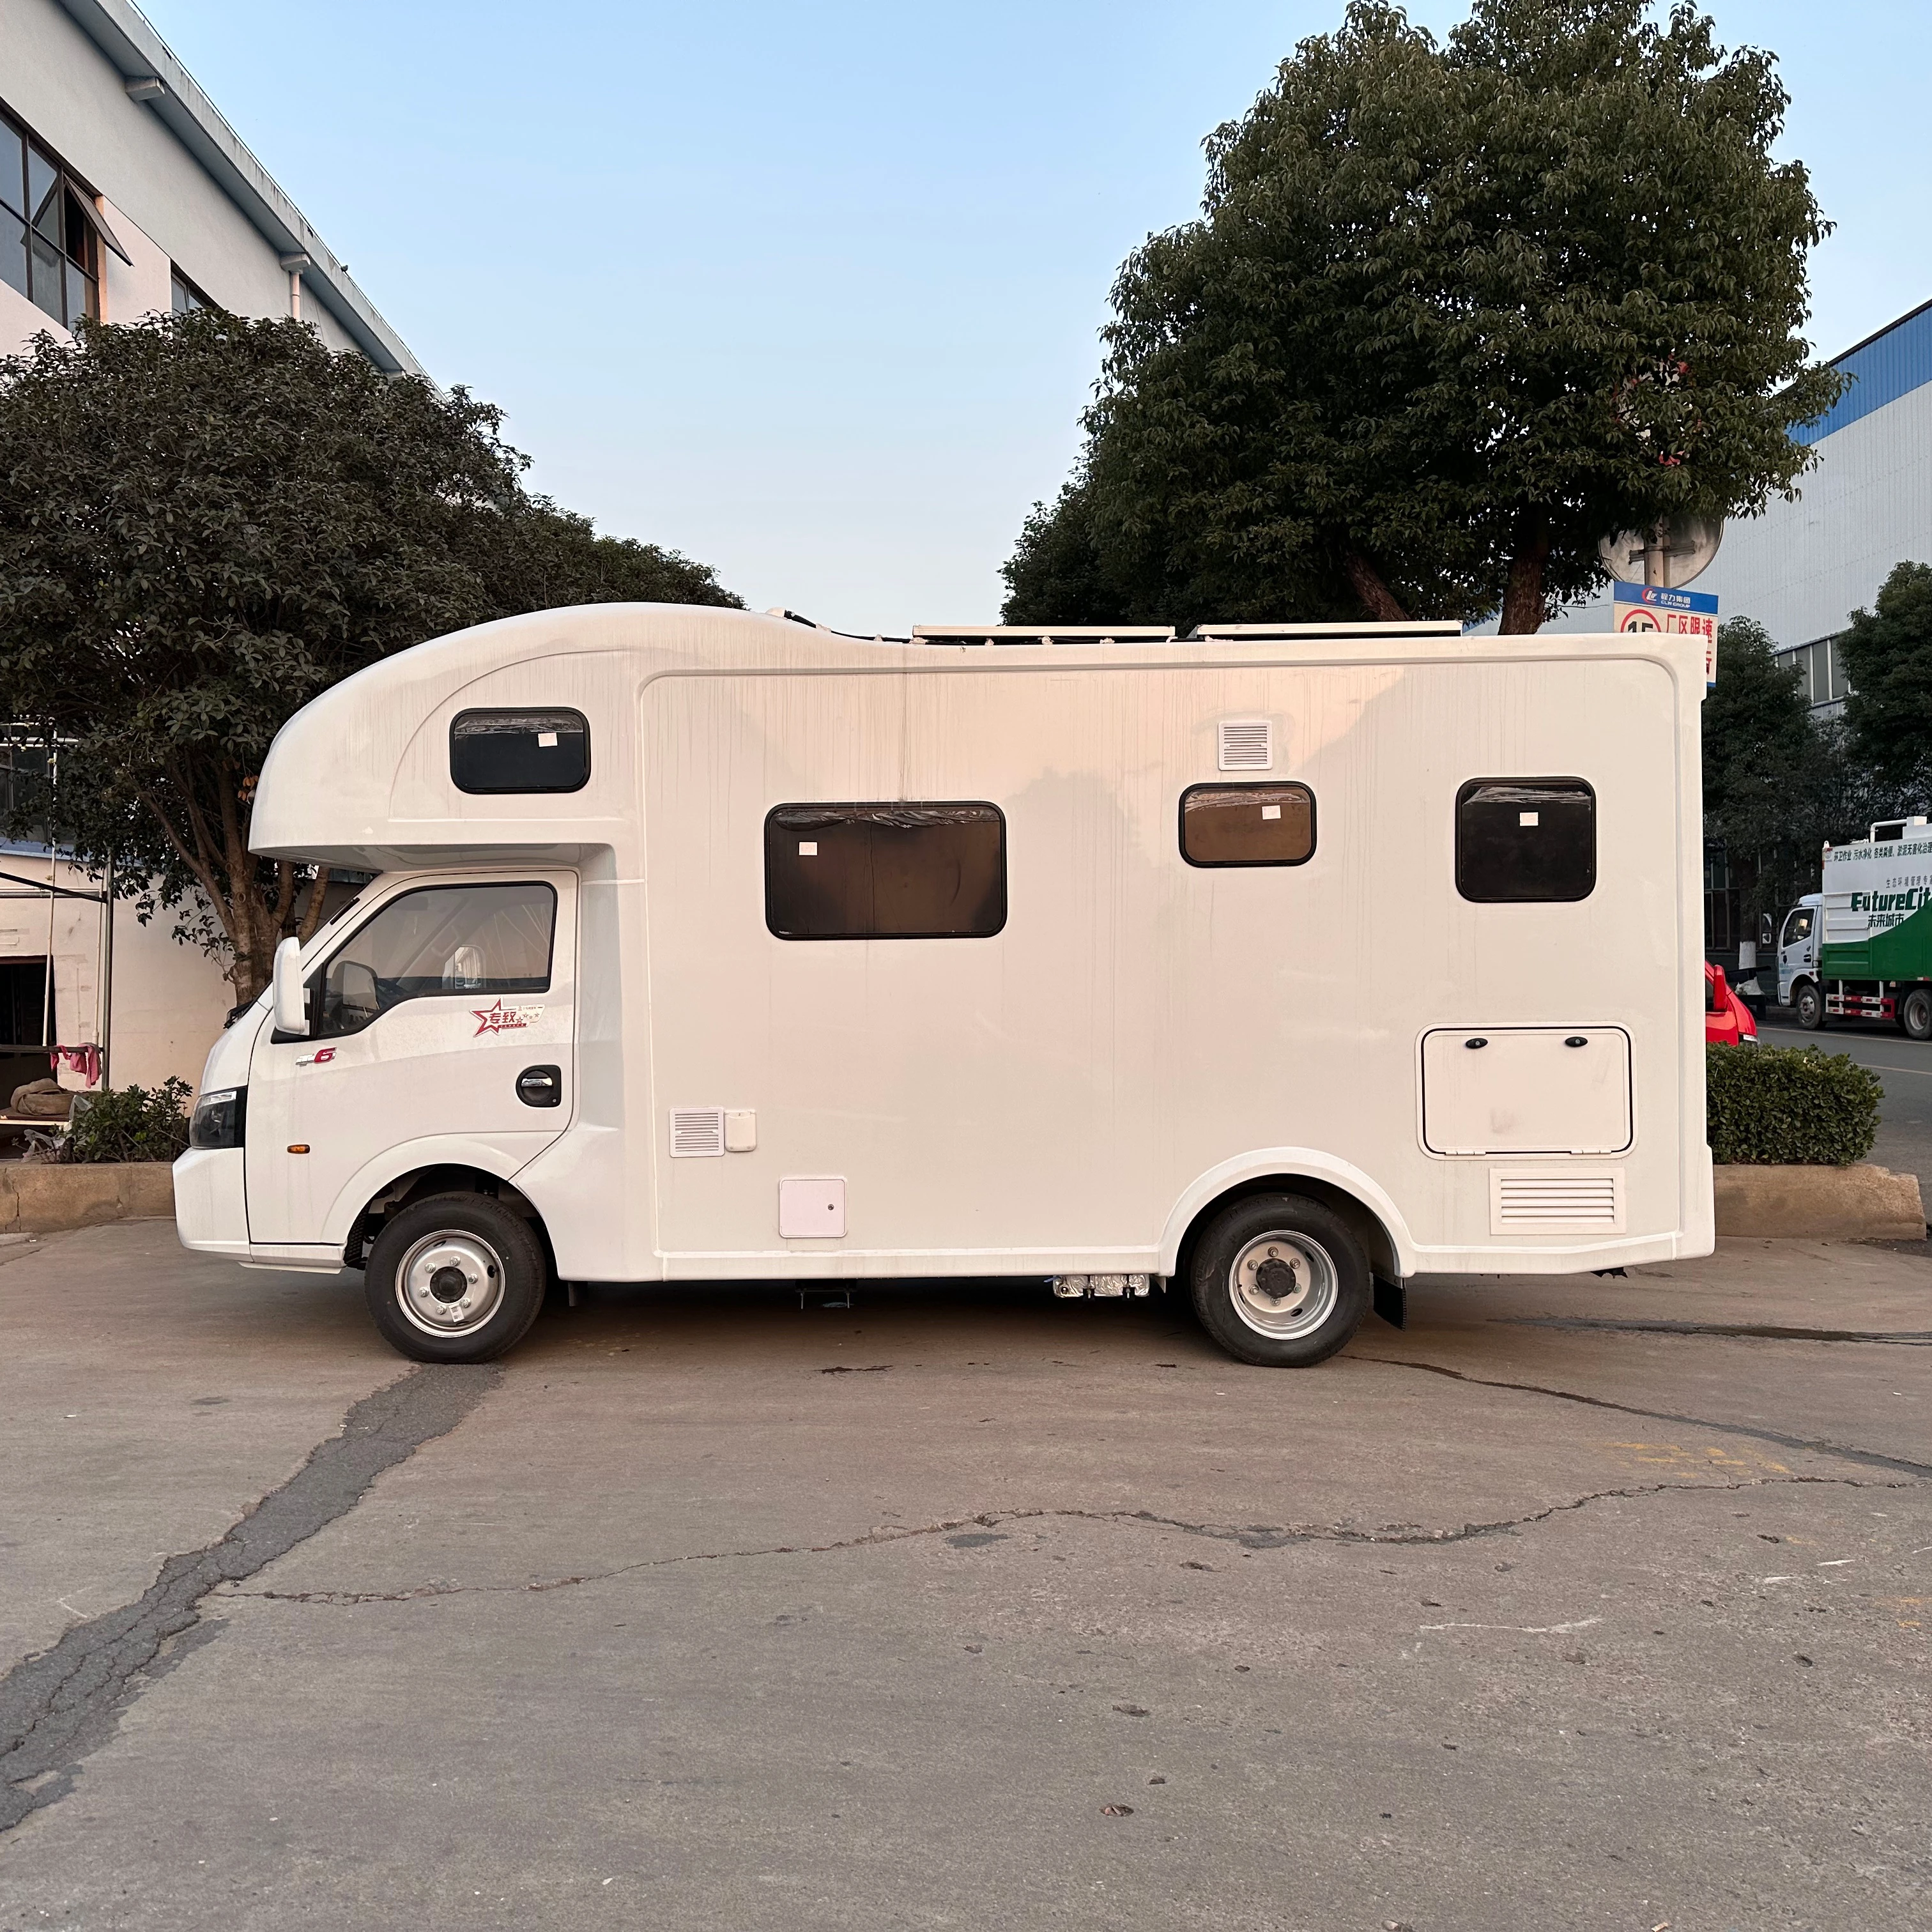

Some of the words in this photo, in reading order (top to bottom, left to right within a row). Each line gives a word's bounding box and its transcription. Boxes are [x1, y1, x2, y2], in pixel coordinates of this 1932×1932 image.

[1660, 592, 1691, 604] 程力集团
[1867, 913, 1905, 928] 未来城市
[489, 1011, 517, 1024] 专致
